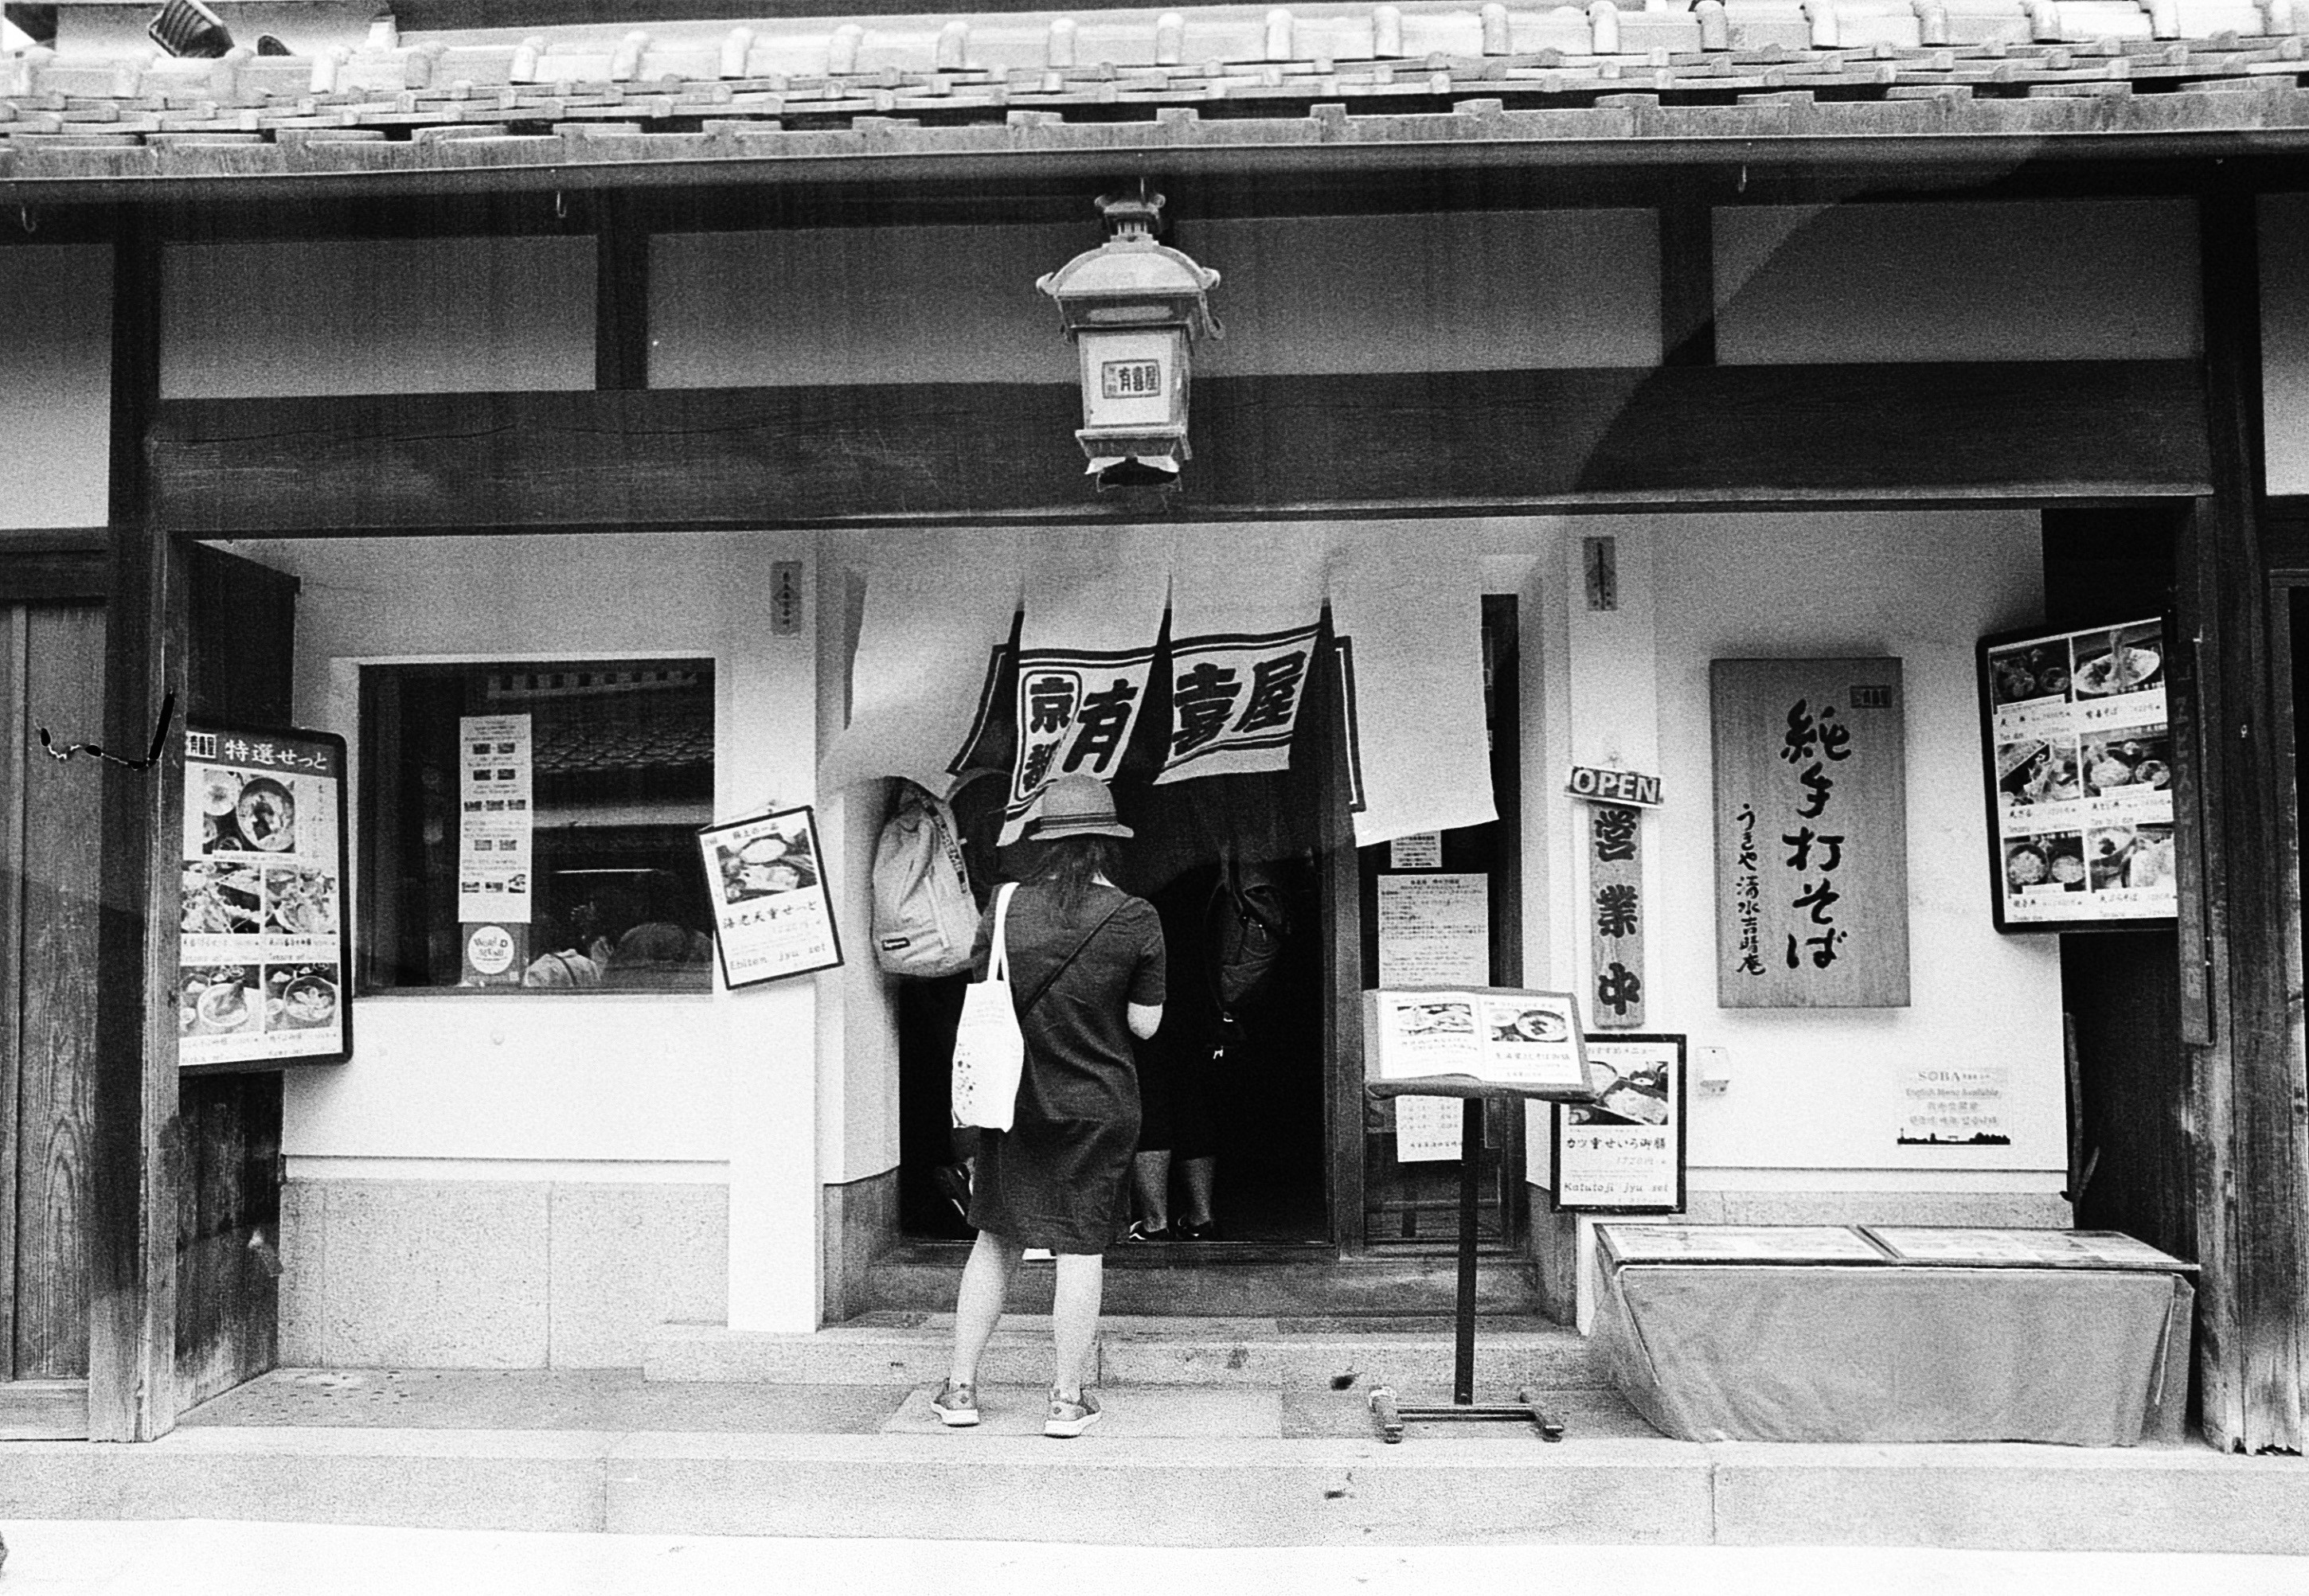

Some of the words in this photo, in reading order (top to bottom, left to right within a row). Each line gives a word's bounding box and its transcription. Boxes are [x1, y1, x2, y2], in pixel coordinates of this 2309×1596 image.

[1062, 650, 1307, 773] 有喜屋
[225, 739, 327, 770] 特選せっと
[1573, 769, 1658, 803] OPEN
[1780, 698, 1852, 969] 純手打そば
[1594, 810, 1641, 1016] 営業中
[809, 943, 826, 954] set
[1918, 1071, 1960, 1082] SOBA
[1623, 1183, 1643, 1193] jyu
[1652, 1184, 1668, 1192] set
